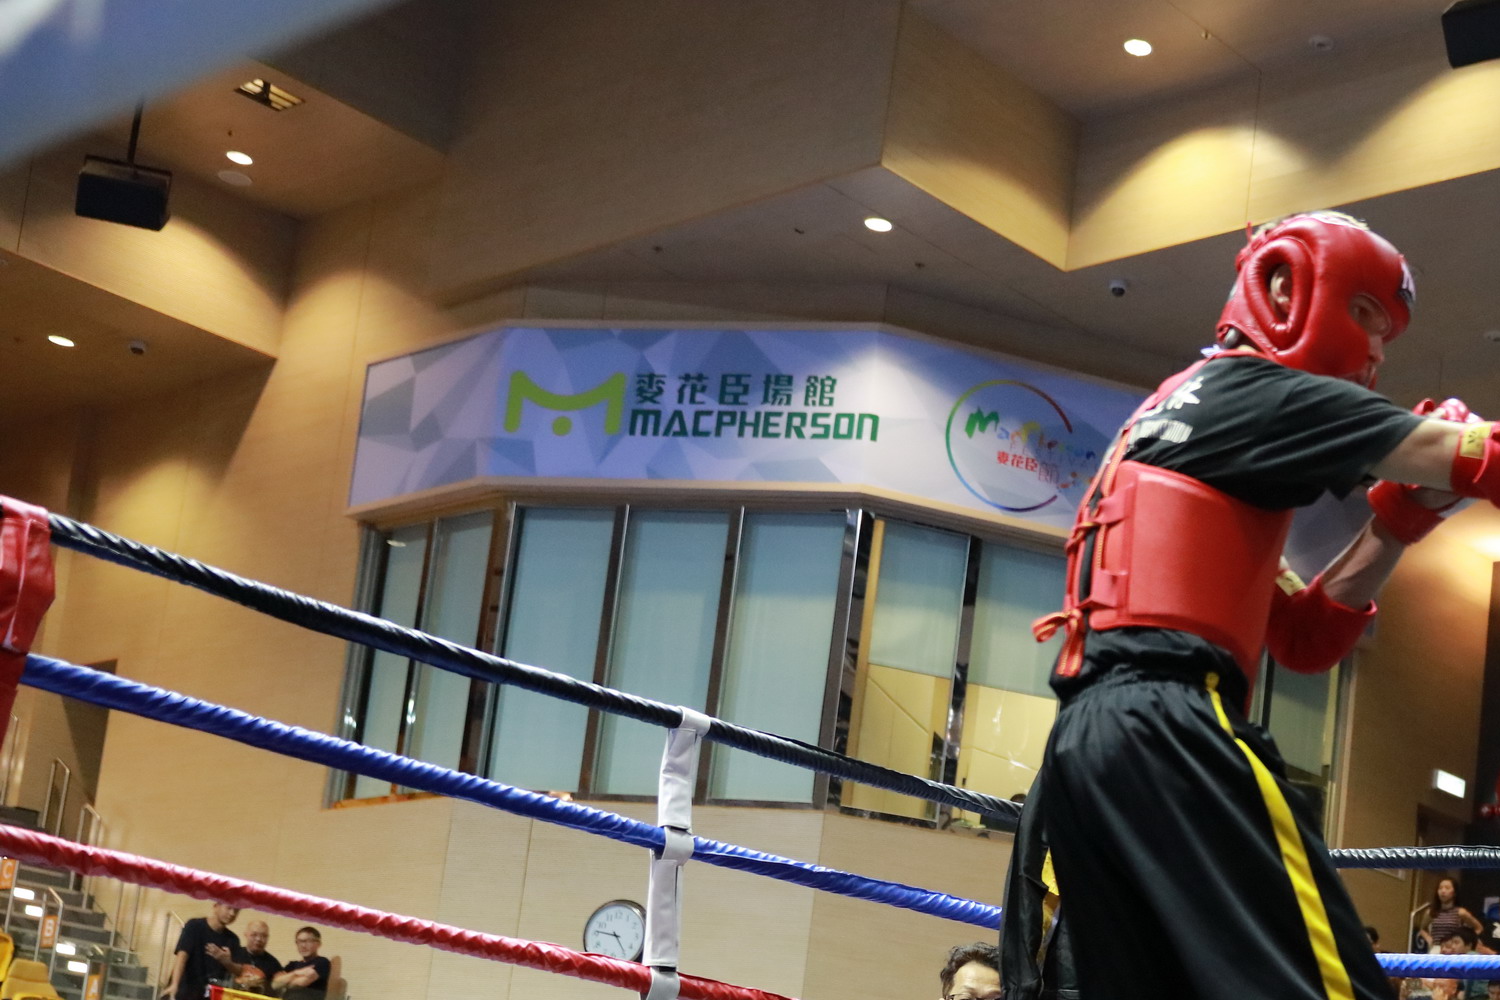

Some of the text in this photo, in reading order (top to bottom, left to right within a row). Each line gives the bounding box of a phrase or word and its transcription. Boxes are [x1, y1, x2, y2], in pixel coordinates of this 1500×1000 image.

[635, 373, 838, 407] 麥花臣場館
[628, 409, 880, 441] MACPHERSON
